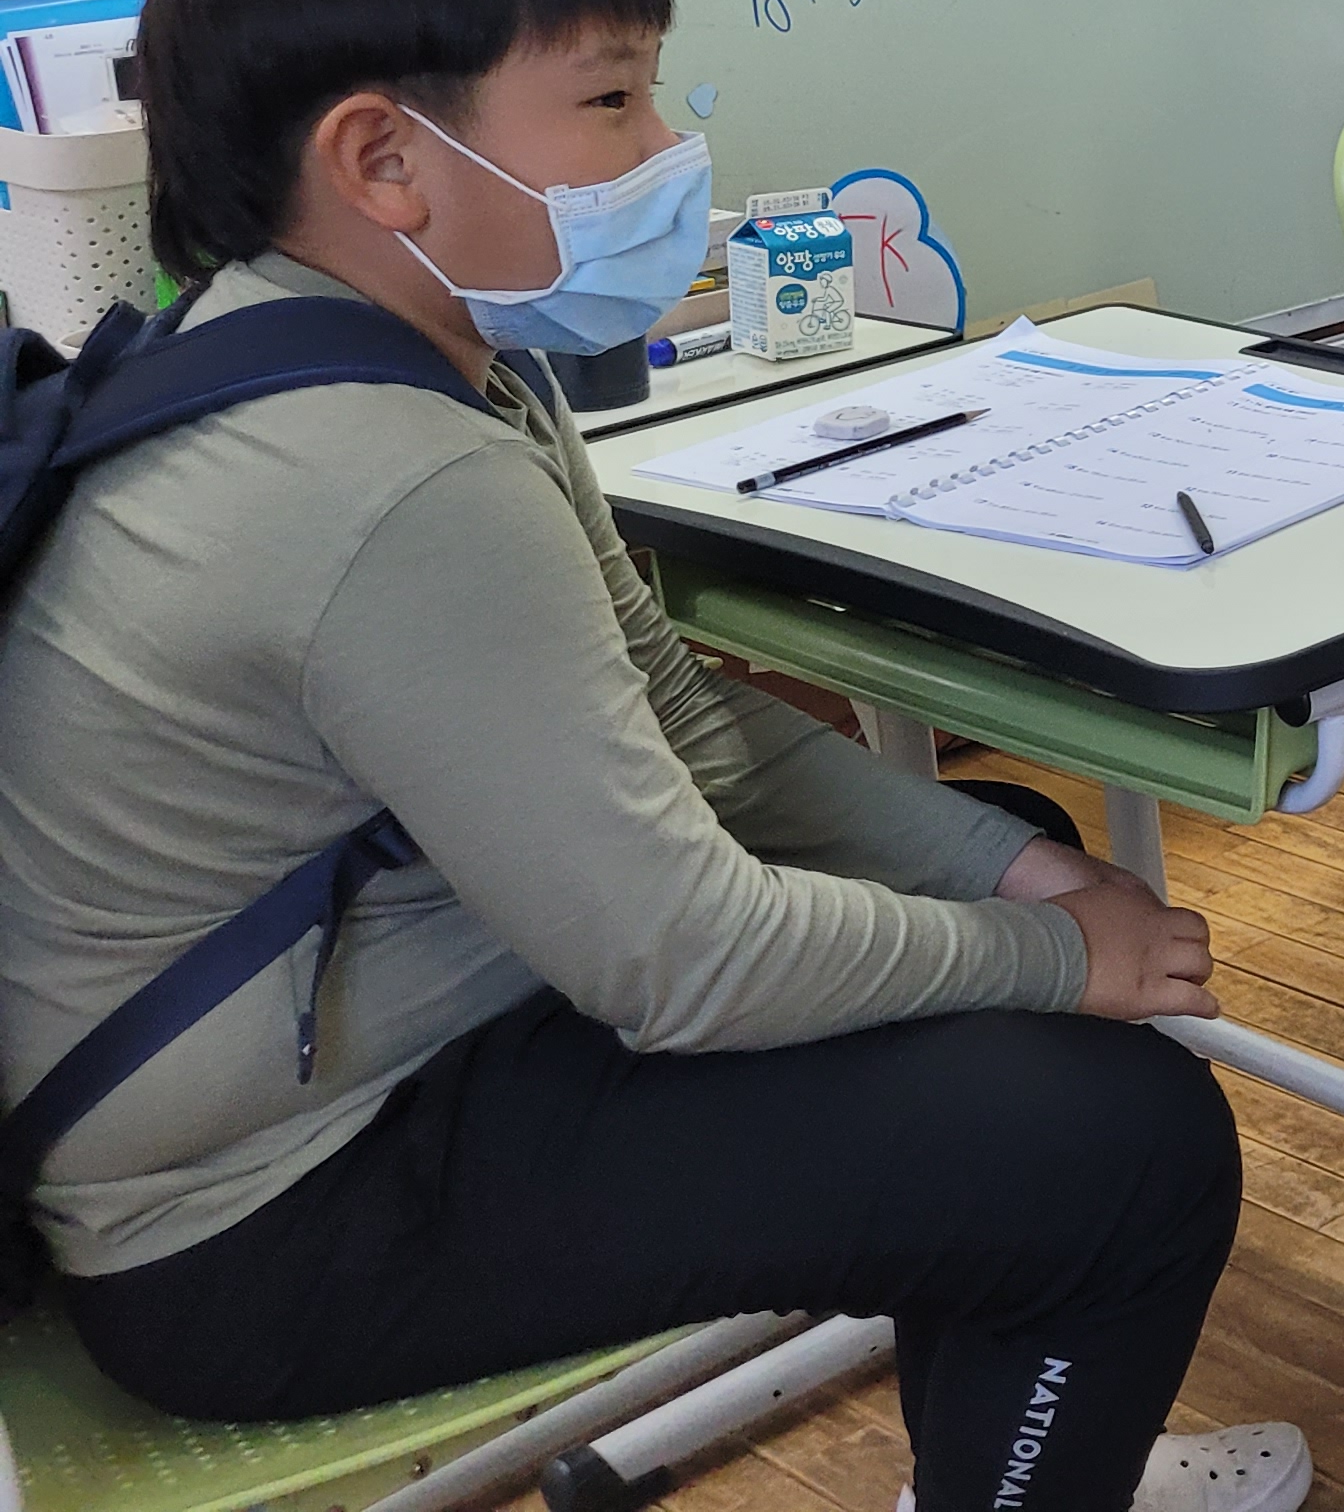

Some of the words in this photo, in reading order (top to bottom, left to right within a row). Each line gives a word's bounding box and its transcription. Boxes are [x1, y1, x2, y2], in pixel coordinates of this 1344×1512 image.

[774, 223, 819, 242] 앙팡
[775, 249, 814, 274] 앙팡
[993, 1356, 1073, 1510] NATIONAL
